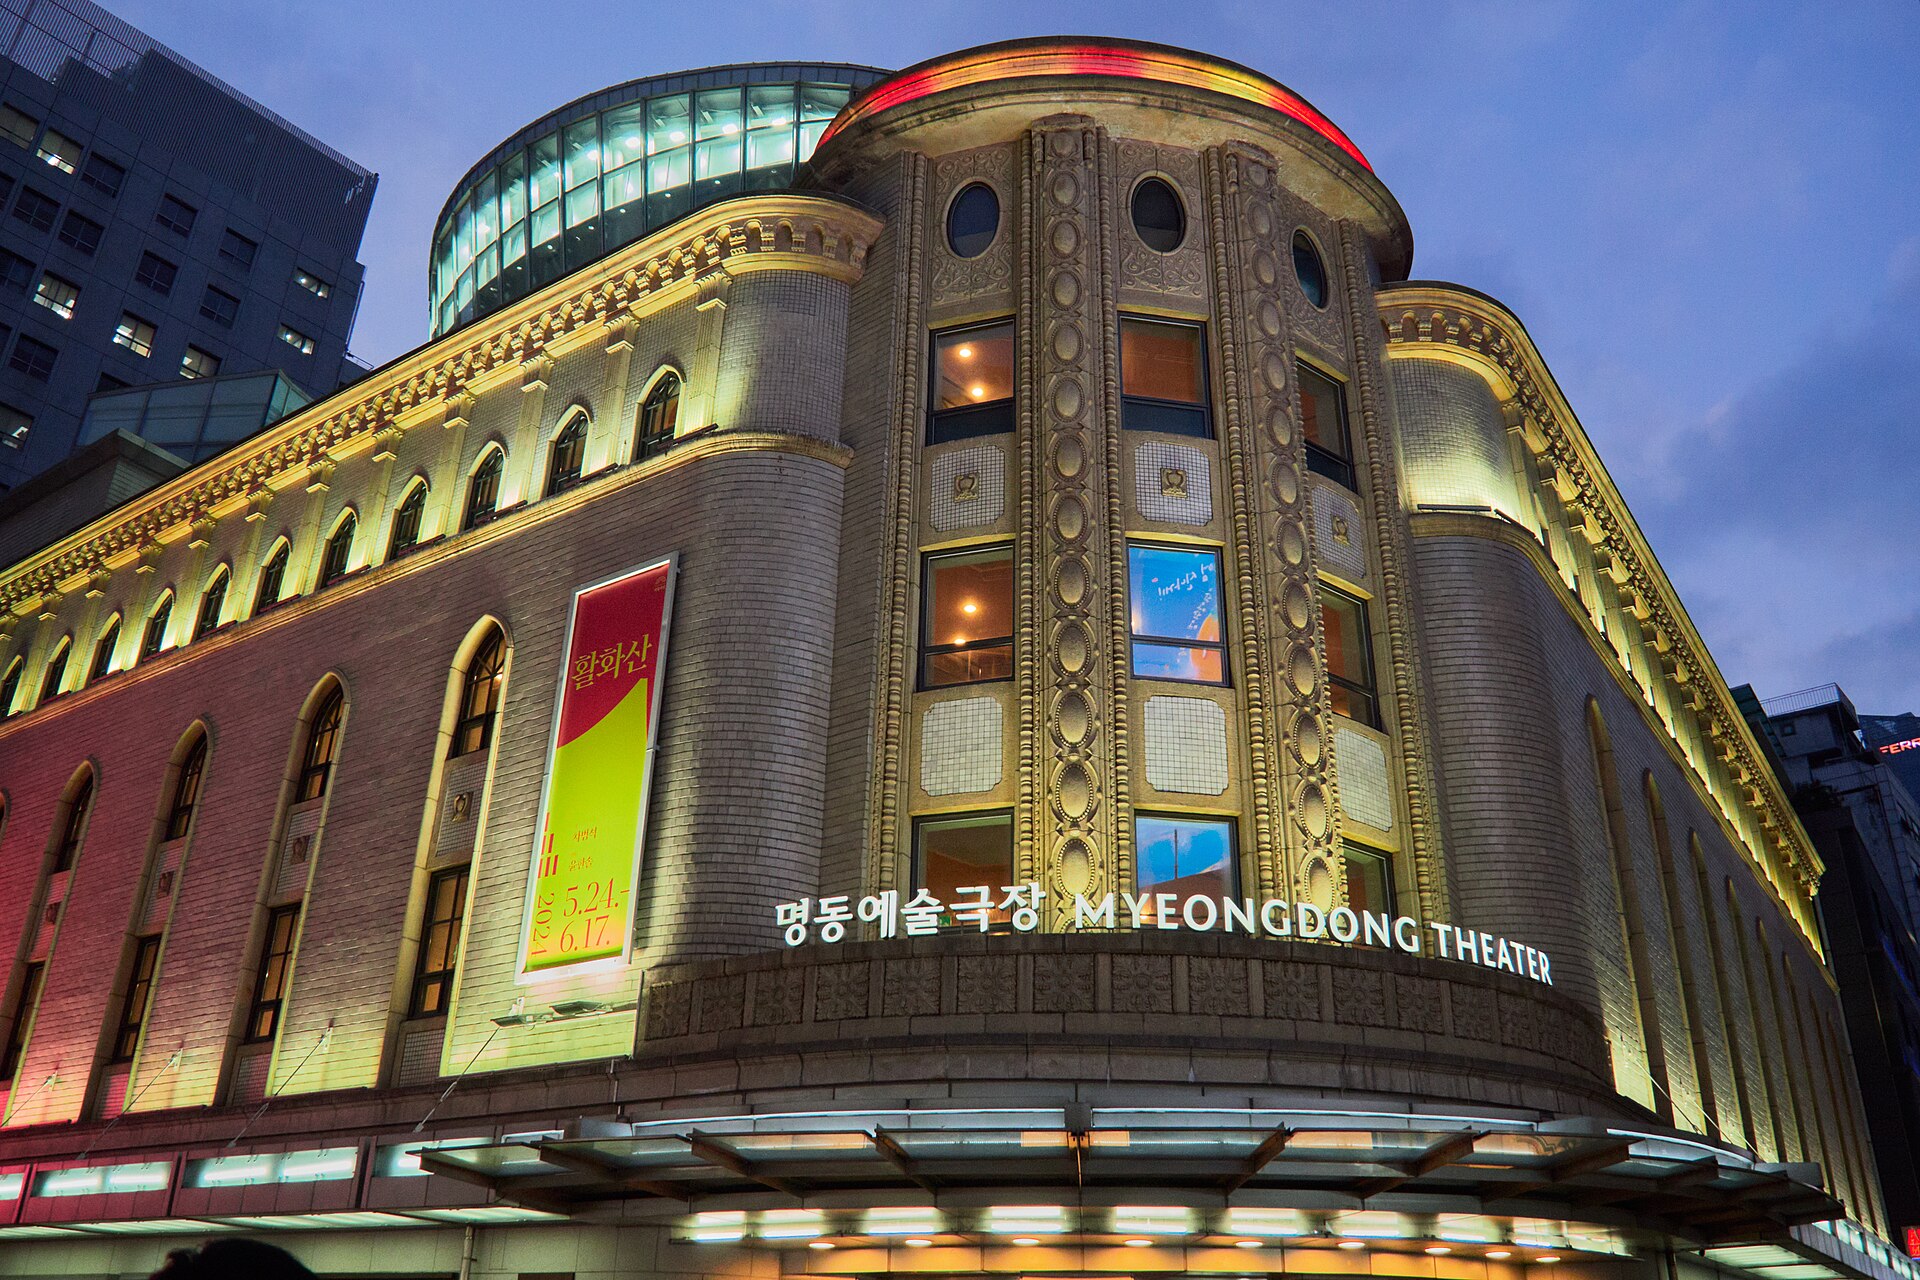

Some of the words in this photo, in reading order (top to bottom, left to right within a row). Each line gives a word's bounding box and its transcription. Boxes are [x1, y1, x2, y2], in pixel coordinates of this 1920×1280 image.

[571, 633, 653, 691] 활화산
[531, 893, 555, 955] 2024
[560, 915, 610, 953] 6.17.
[775, 882, 1047, 947] 명동예술극장
[1074, 892, 1420, 954] MYEONGDONG
[1430, 921, 1553, 986] THEATER
